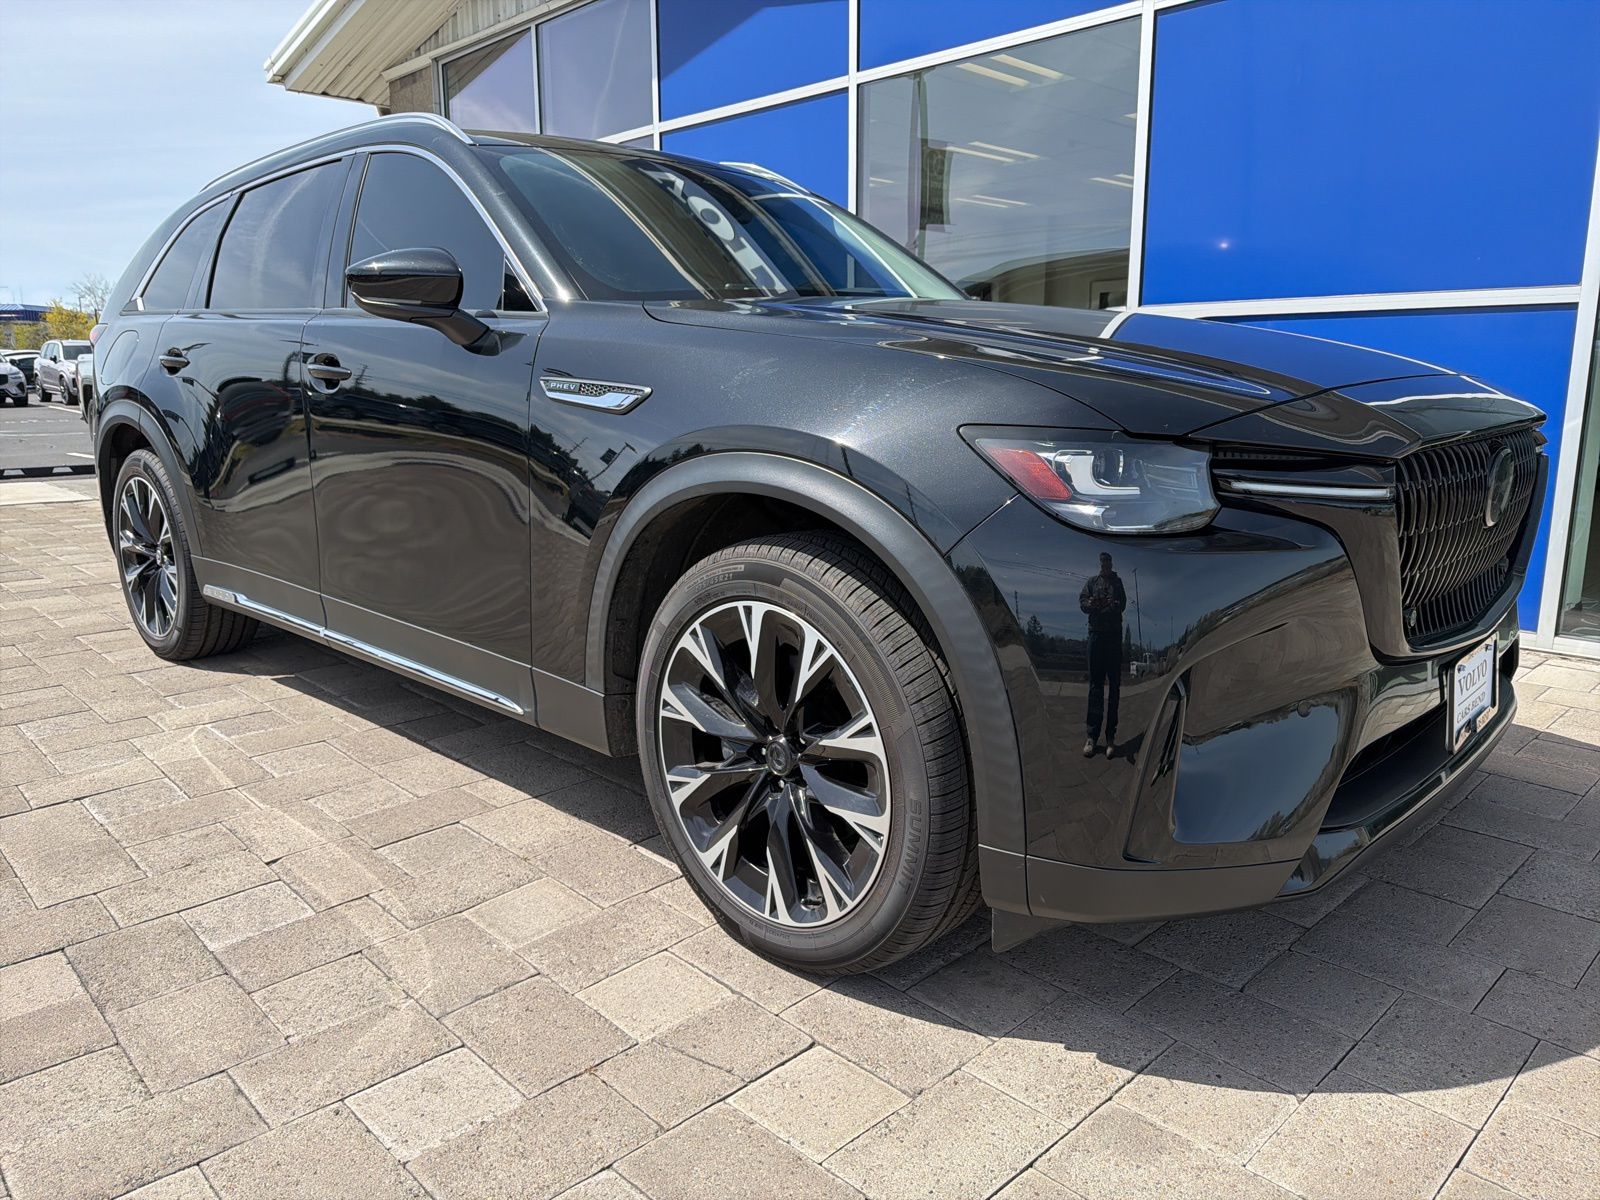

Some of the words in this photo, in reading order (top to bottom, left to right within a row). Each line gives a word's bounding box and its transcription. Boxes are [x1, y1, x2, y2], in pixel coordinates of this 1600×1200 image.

[550, 382, 576, 390] PHEV
[1458, 659, 1488, 696] VOLVO
[1456, 704, 1471, 724] CARS
[1471, 691, 1486, 711] BEND
[899, 800, 922, 895] SUMMIT
